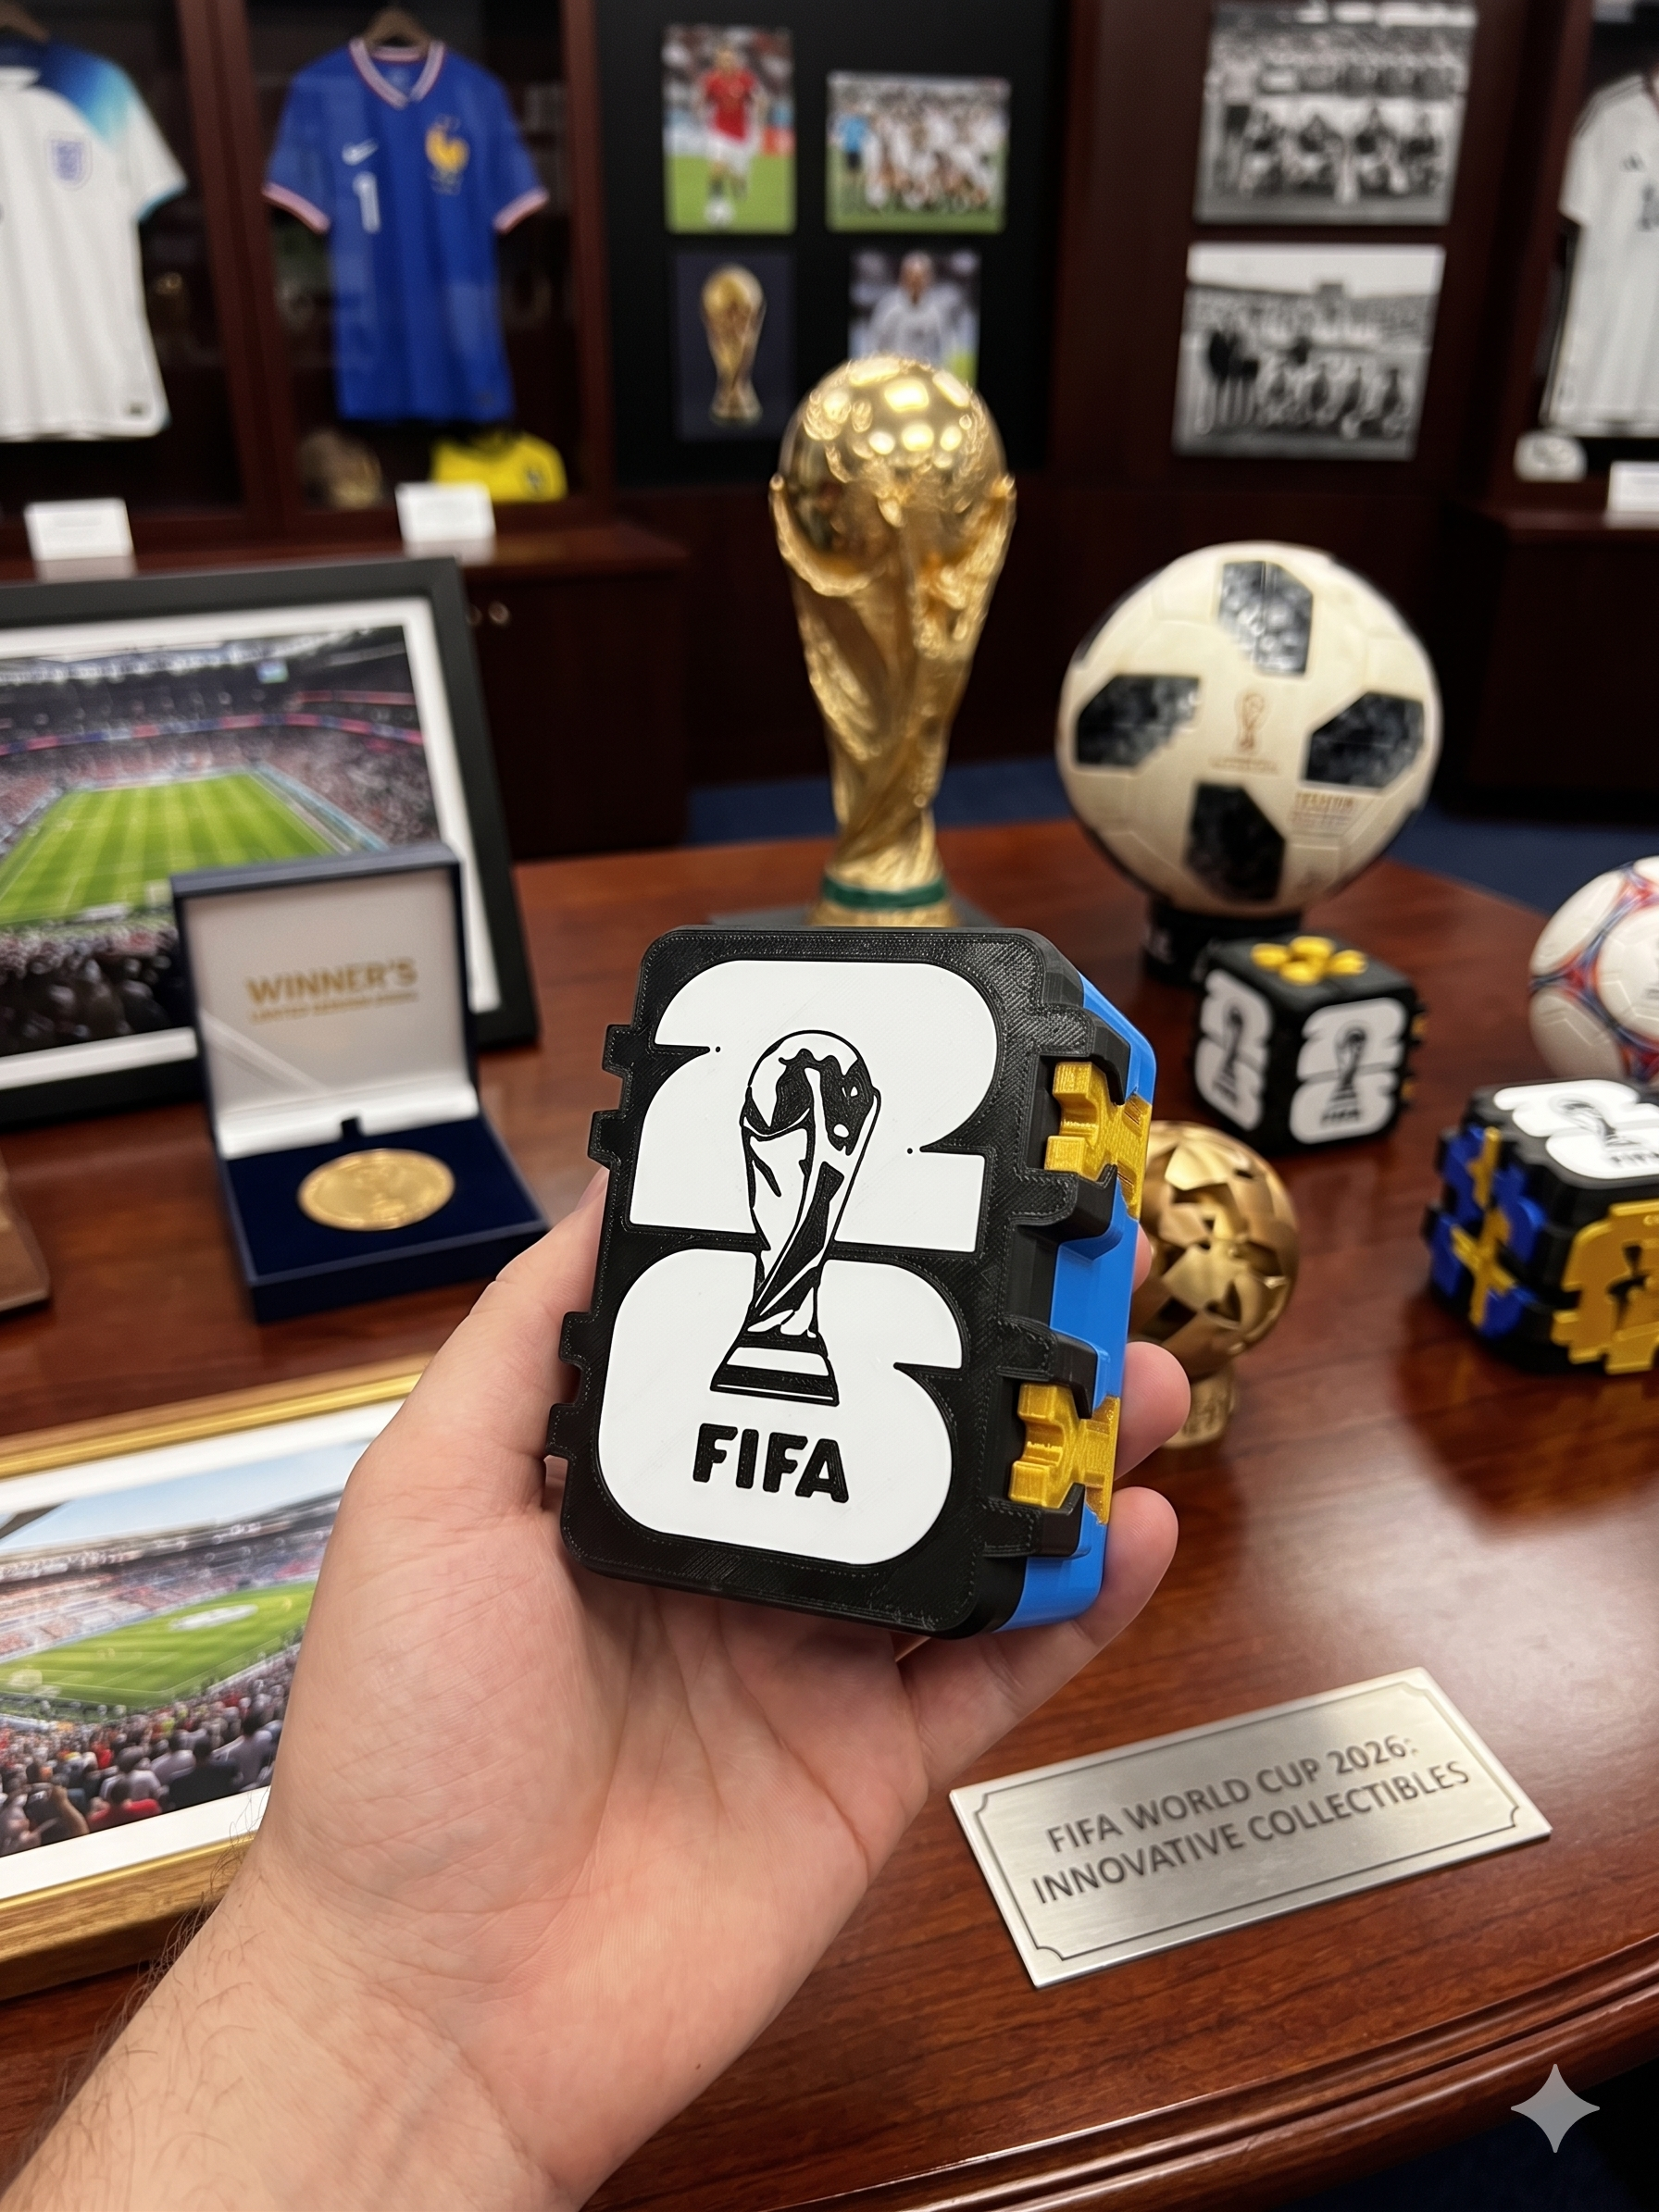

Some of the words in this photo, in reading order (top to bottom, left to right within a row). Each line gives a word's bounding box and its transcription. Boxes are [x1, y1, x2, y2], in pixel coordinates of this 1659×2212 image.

[352, 172, 381, 231] 1
[246, 957, 418, 1006] WINNER'S
[692, 1423, 849, 1503] FIFA
[1031, 1822, 1246, 1904] INNOVATIVE
[1247, 1760, 1470, 1841] COLLECTIBLES
[1046, 1813, 1124, 1853] FIFA
[1121, 1778, 1250, 1830] WORLD
[1256, 1758, 1321, 1794] CUP
[1326, 1734, 1419, 1775] 2026:
